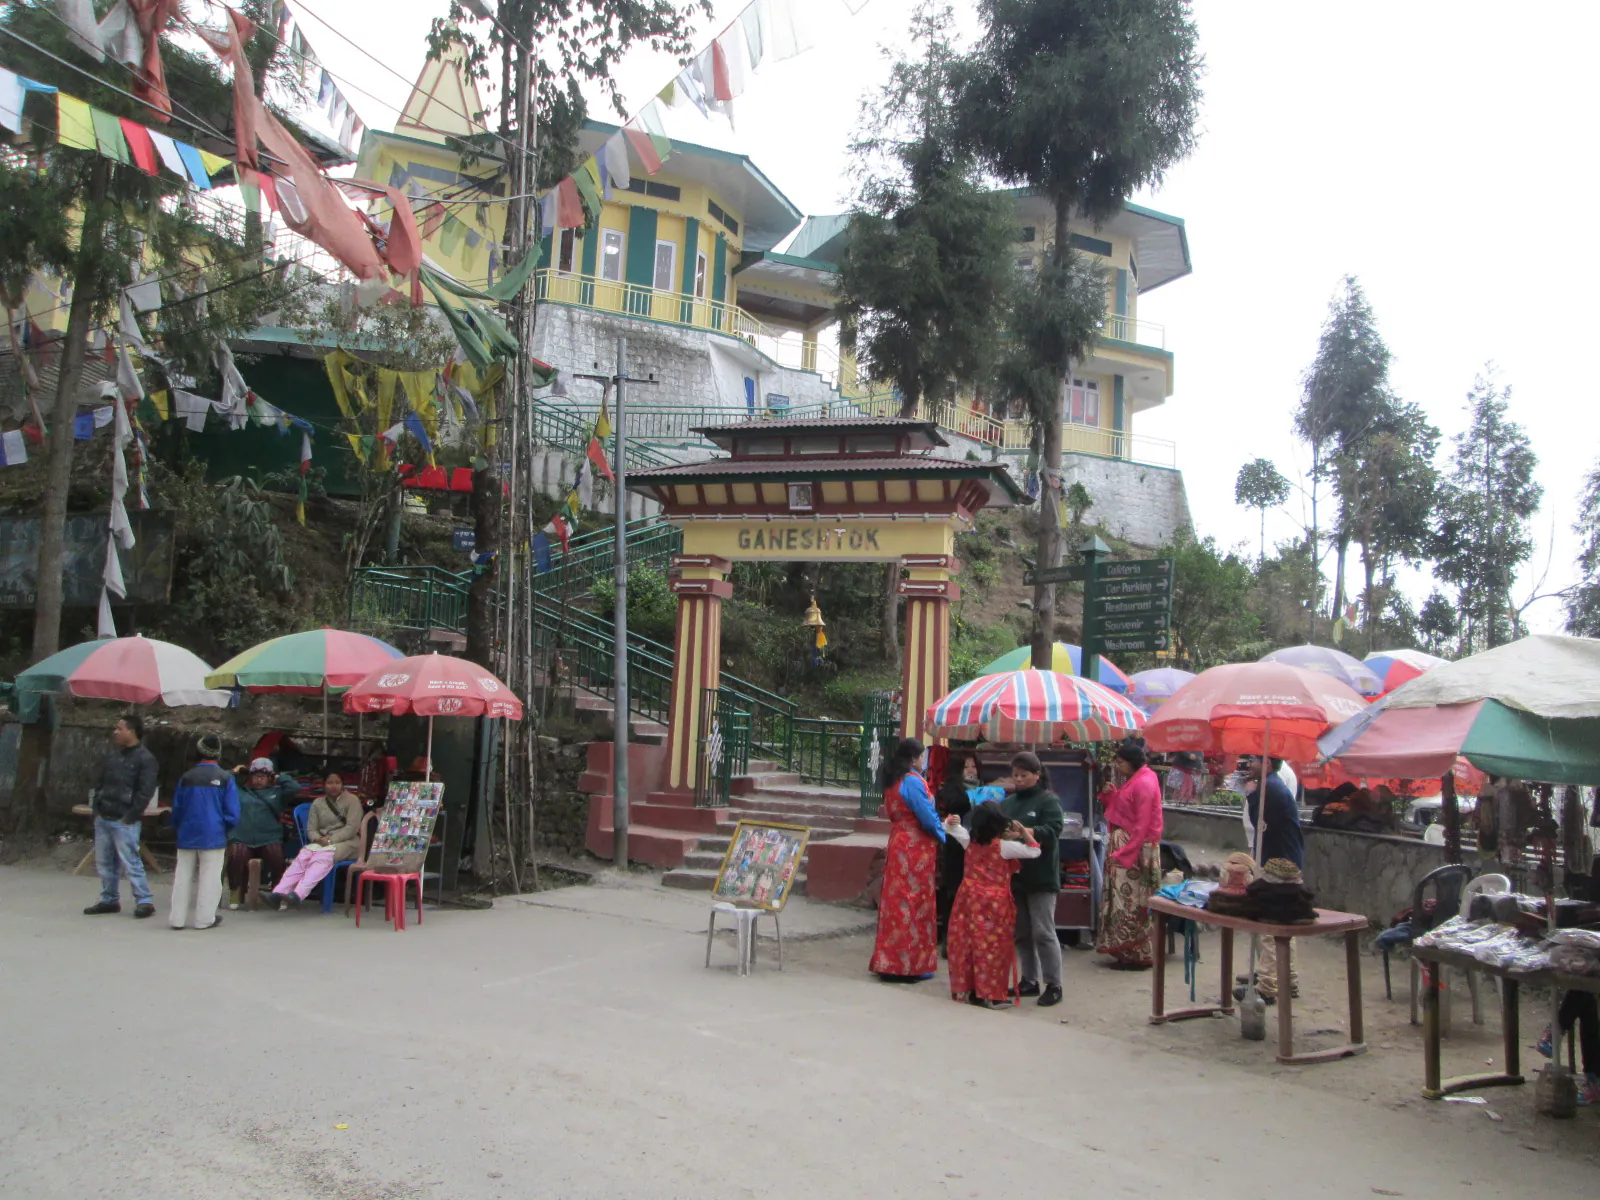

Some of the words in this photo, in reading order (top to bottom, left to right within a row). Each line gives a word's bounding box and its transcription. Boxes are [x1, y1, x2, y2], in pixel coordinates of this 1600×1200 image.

[738, 528, 881, 551] GANESHTOK
[1106, 565, 1141, 576] Cafeteria
[1105, 584, 1121, 595] Car
[1121, 582, 1152, 594] Parking
[1105, 601, 1152, 612] Restaurant
[1104, 619, 1144, 631] Souvenir
[1105, 639, 1146, 650] Washroom
